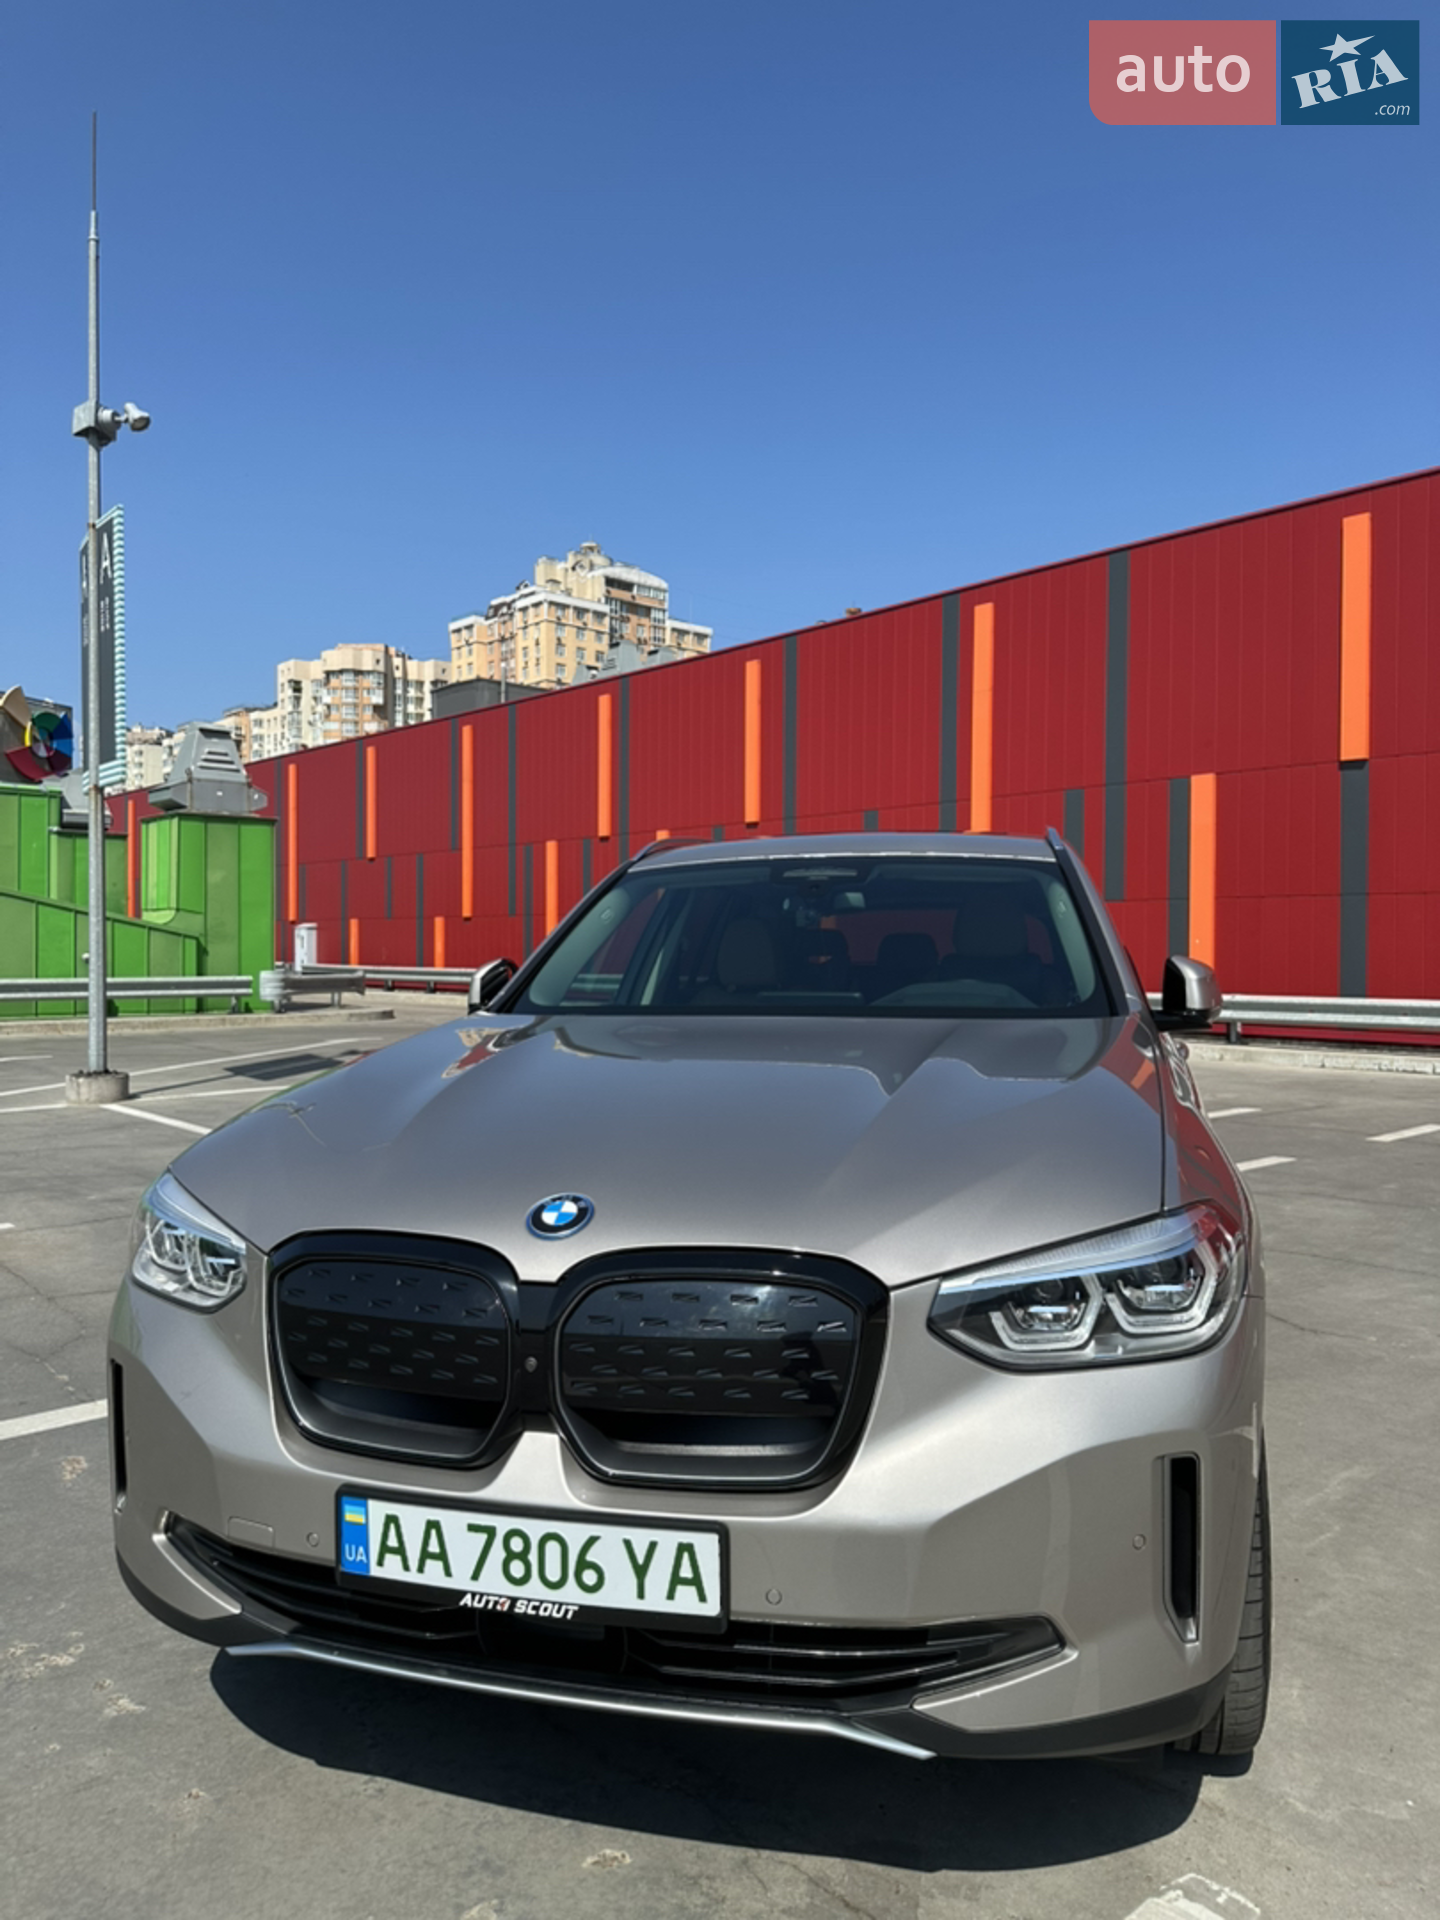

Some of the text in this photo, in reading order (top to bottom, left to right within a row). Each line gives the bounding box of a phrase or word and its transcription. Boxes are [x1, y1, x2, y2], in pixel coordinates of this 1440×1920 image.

[345, 1543, 367, 1563] UA
[376, 1513, 708, 1603] AA 7806 YA
[459, 1592, 579, 1620] AUTO SCOUT
